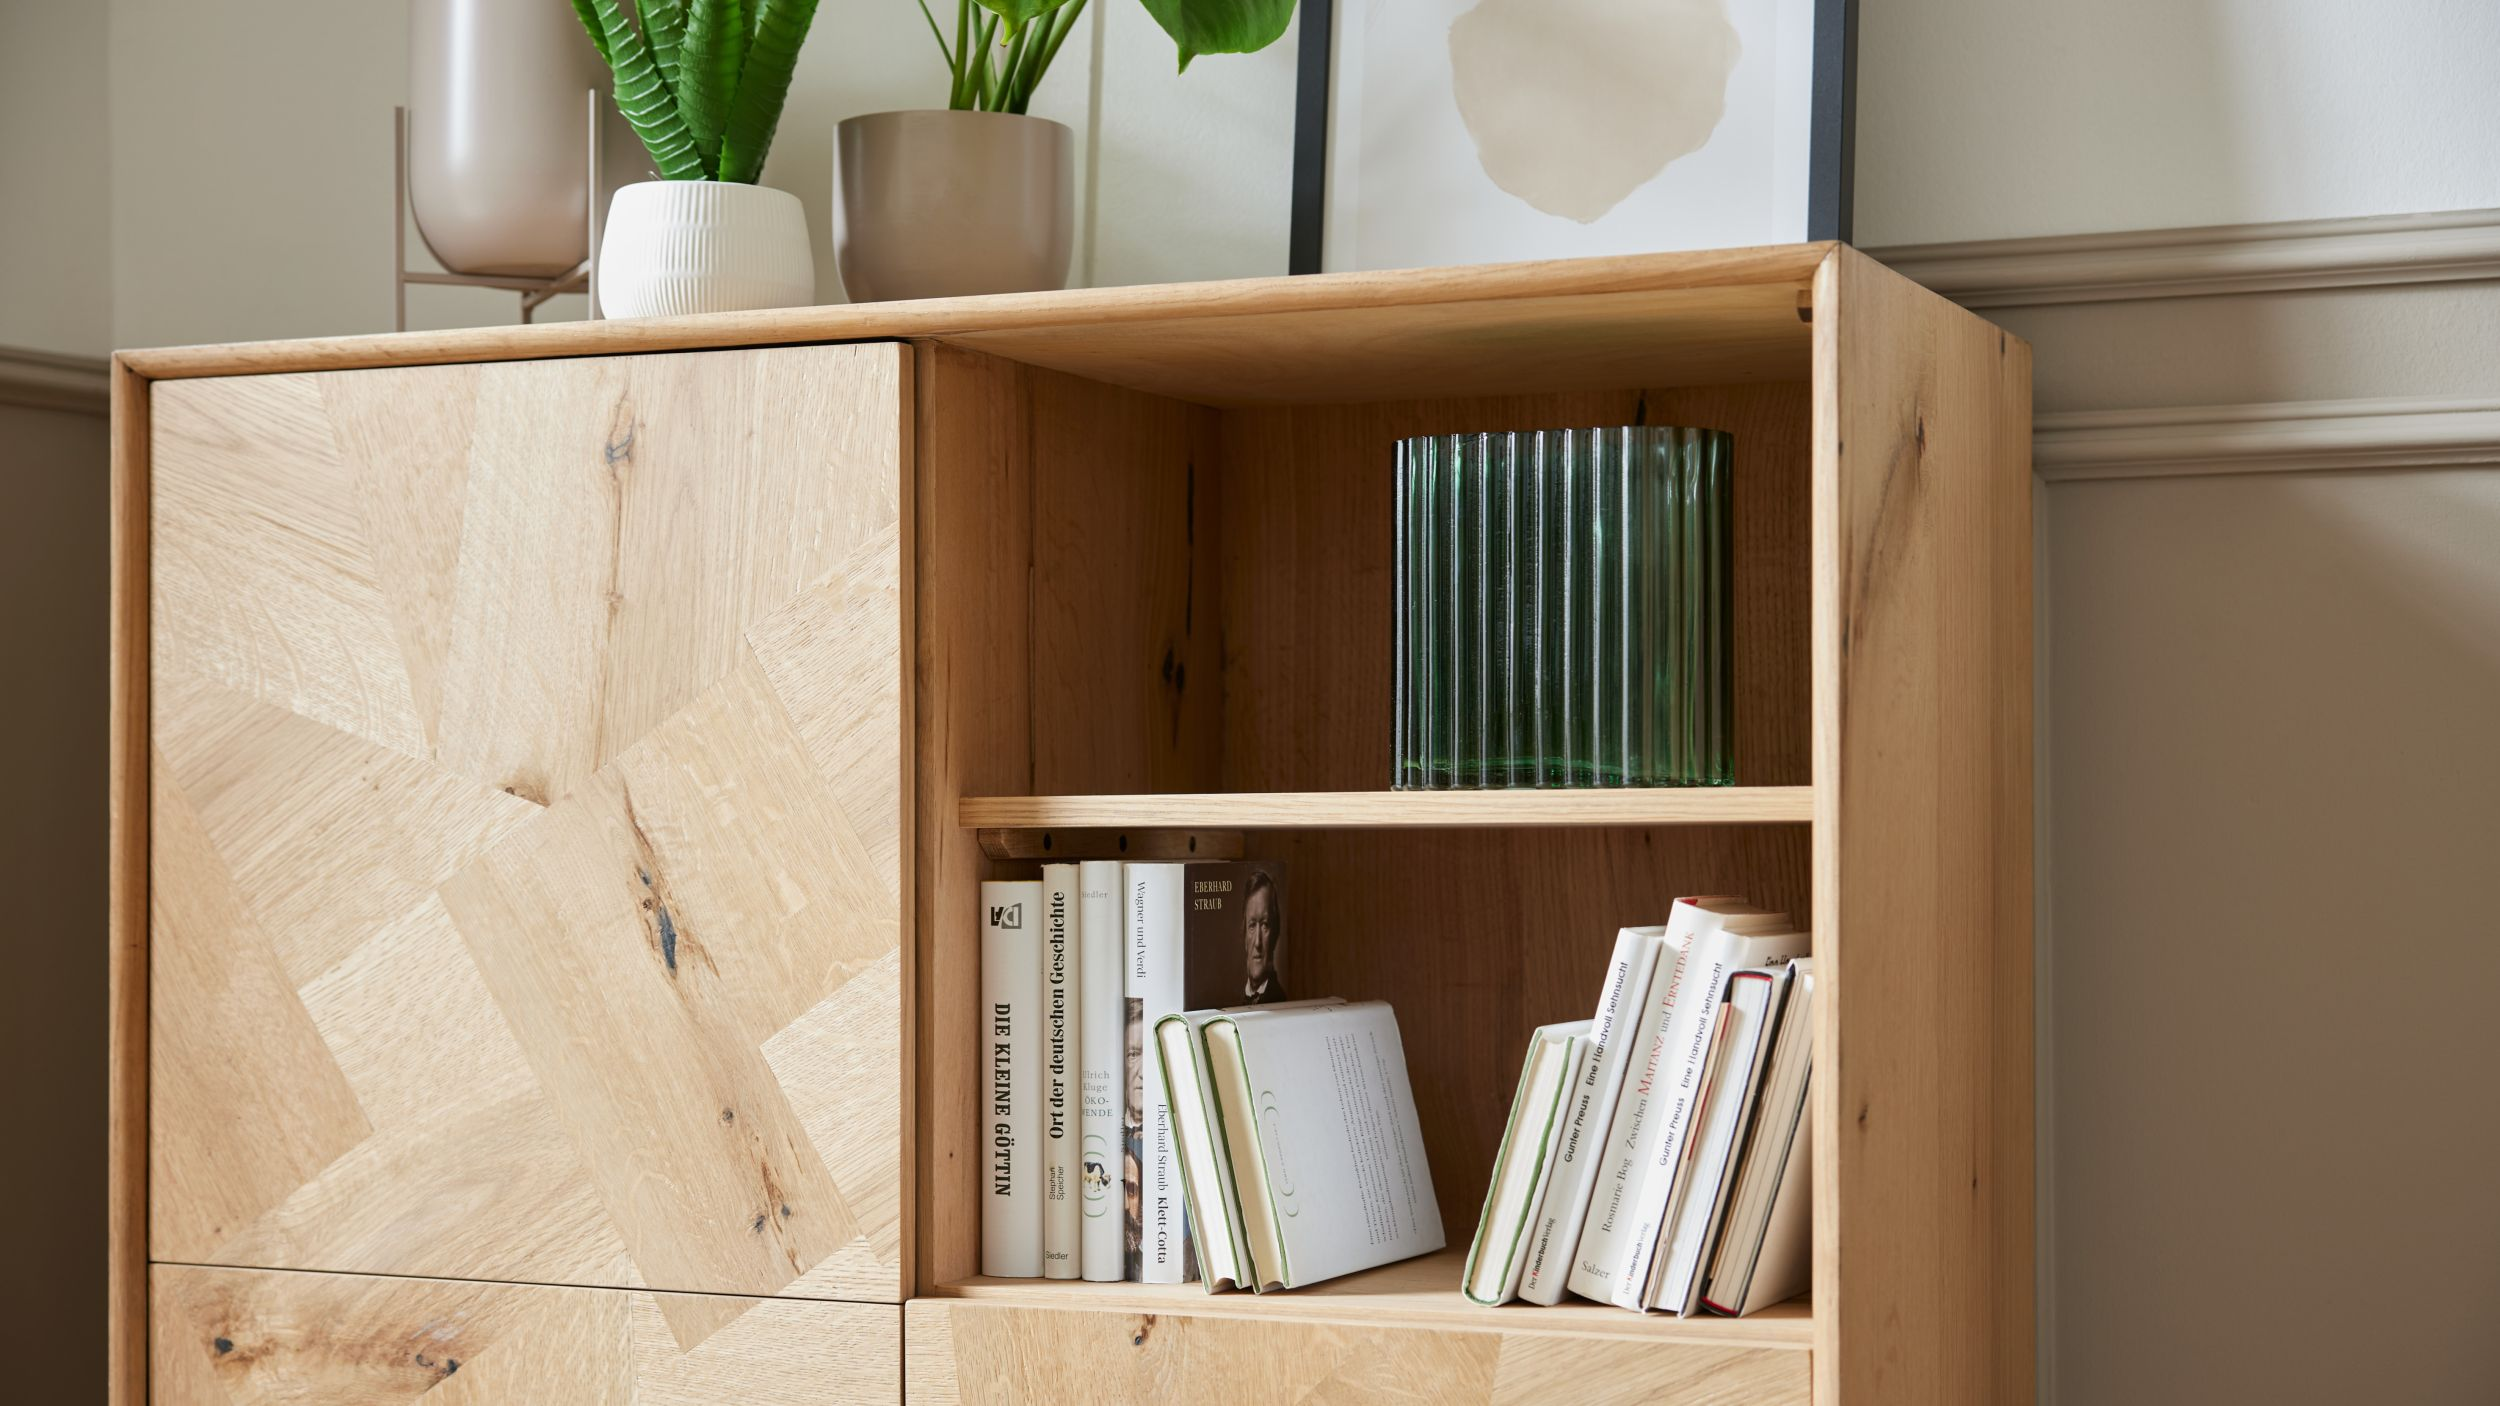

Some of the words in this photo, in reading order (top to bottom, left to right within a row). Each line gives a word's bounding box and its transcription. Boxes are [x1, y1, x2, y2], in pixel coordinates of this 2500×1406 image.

[1135, 881, 1146, 924] Wagner
[1194, 881, 1232, 893] EBERHARD
[1194, 898, 1222, 910] STRAUB
[1050, 891, 1064, 985] Geschichte
[1137, 926, 1146, 947] und
[1137, 950, 1146, 978] Verdi
[1662, 931, 1695, 1008] ERNTEDANK
[994, 1003, 1011, 1037] DIE
[1050, 988, 1064, 1075] deutschen
[1660, 1010, 1672, 1033] und
[1574, 1094, 1591, 1126] Preuss
[1585, 1064, 1599, 1086] Eine
[1592, 1015, 1613, 1063] Handvoll
[1607, 962, 1628, 1014] Sehnsucht
[1669, 1097, 1685, 1129] Preuss
[1680, 1066, 1694, 1089] Eine
[1688, 1015, 1708, 1065] Handvoll
[1701, 962, 1723, 1015] Sehnsucht
[994, 1043, 1011, 1116] KLEINE
[1050, 1079, 1064, 1108] der
[1049, 1111, 1064, 1139] Ort
[1157, 1104, 1169, 1153] Eberhard
[1625, 1099, 1648, 1150] Zwischen
[994, 1123, 1015, 1197] GÖTTIN
[1157, 1154, 1169, 1191] Straub
[1617, 1158, 1633, 1182] Bog
[1049, 1167, 1057, 1200] Stephan
[1056, 1165, 1065, 1200] Speicher
[1602, 1183, 1625, 1232] Rosmarie
[1157, 1197, 1169, 1264] Klett-Cotta
[1528, 1276, 1538, 1290] Der
[1581, 1260, 1611, 1280] Salzer
